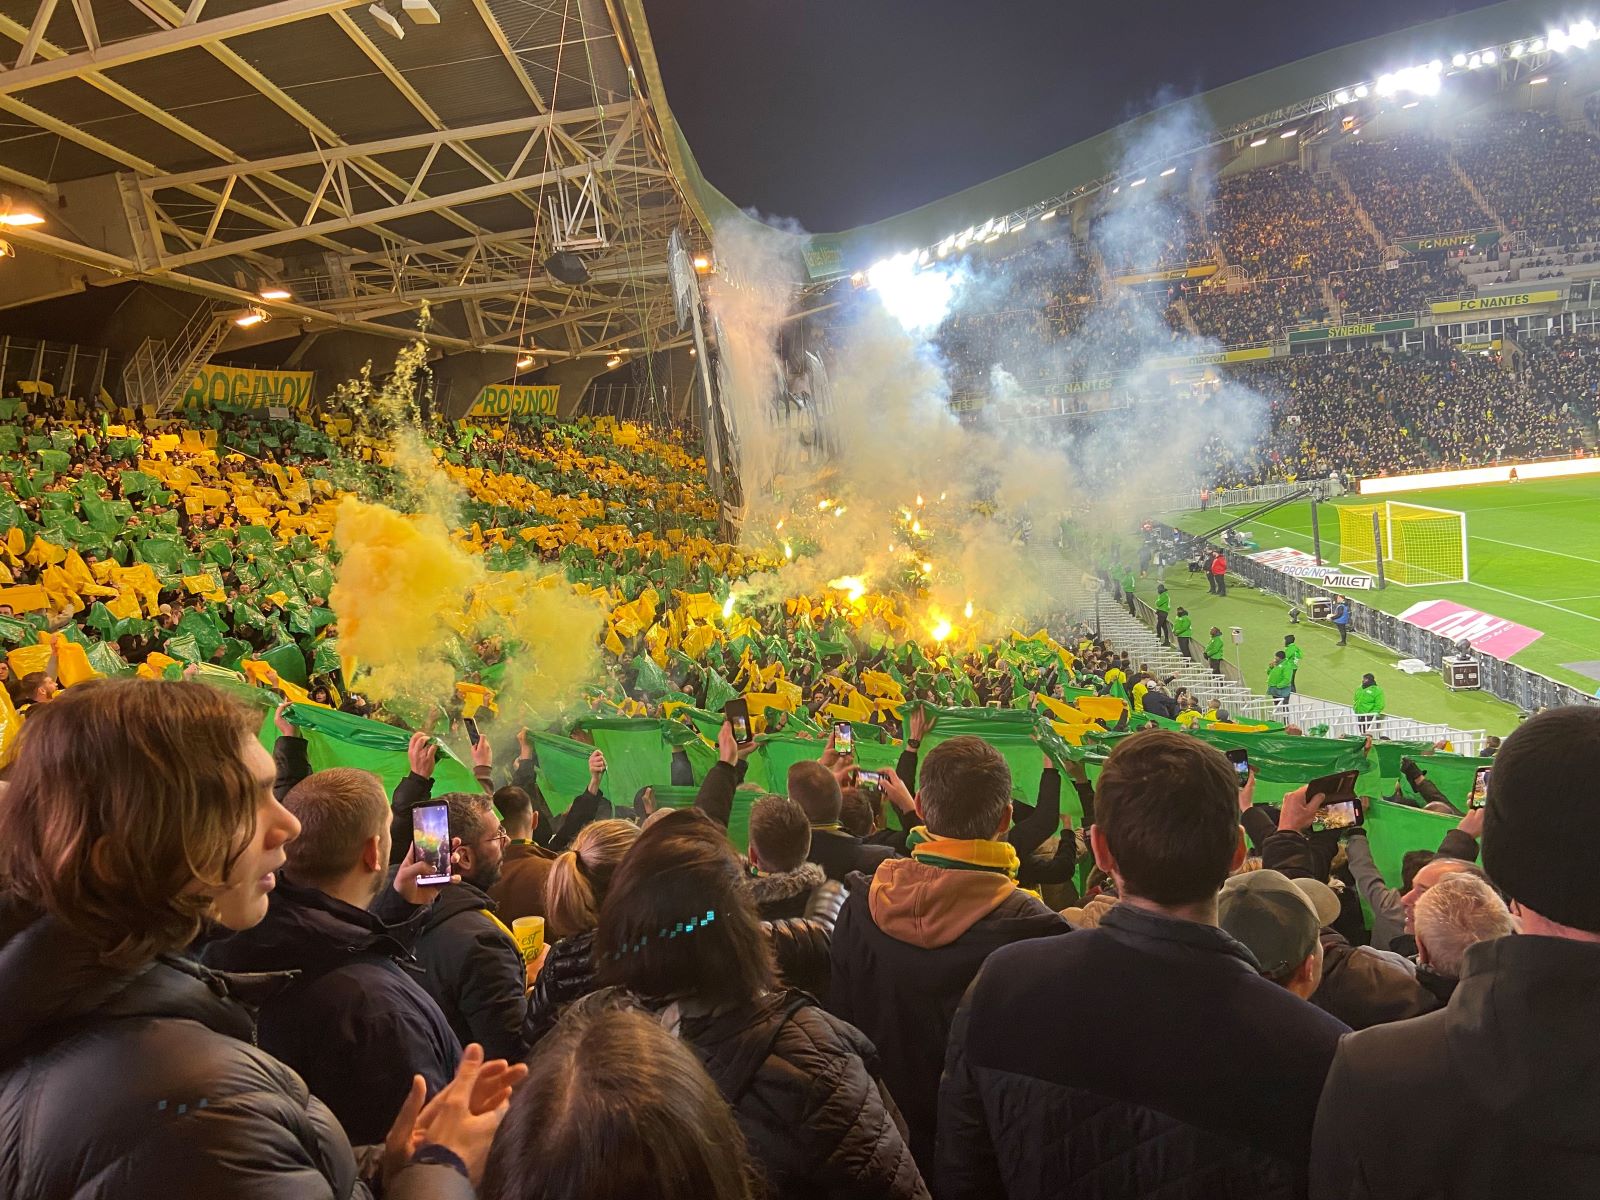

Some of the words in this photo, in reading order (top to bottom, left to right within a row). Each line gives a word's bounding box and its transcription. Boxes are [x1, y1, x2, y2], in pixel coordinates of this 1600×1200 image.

[1418, 240, 1432, 250] FC
[1434, 235, 1477, 248] NANTES
[1460, 301, 1475, 311] FC
[1480, 295, 1529, 308] NANTES
[1328, 323, 1376, 338] SYNERGIE
[183, 371, 311, 408] ROGINOV
[1064, 379, 1113, 393] NANTES
[1324, 575, 1369, 587] MILLET
